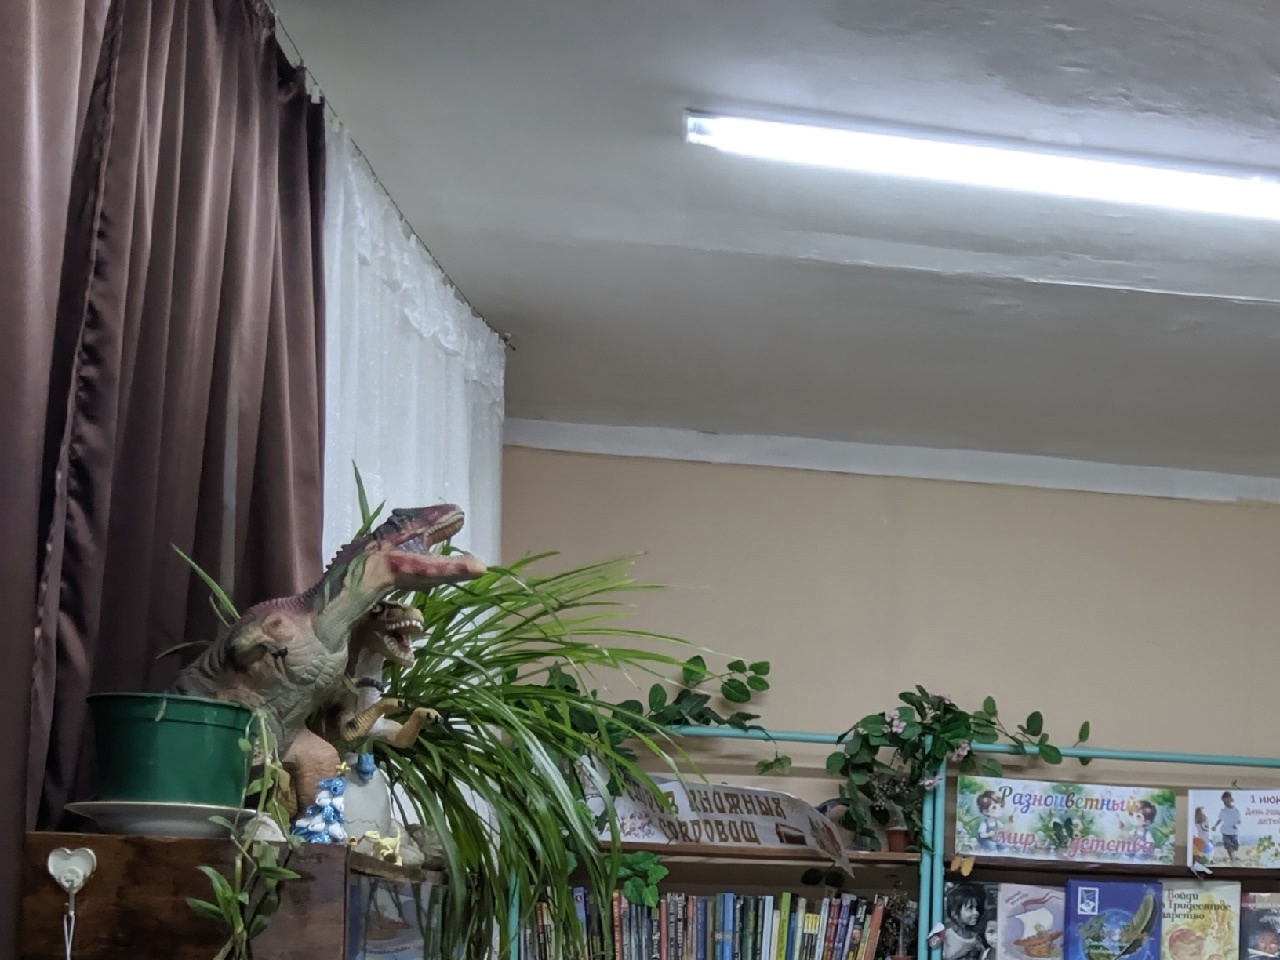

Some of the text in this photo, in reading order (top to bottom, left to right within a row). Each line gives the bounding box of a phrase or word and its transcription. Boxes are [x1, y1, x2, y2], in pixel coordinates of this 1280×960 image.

[998, 785, 1138, 814] Разноцветны
[1250, 794, 1257, 804] 1
[995, 830, 1155, 858] мир детства
[1168, 889, 1199, 903] Войди
